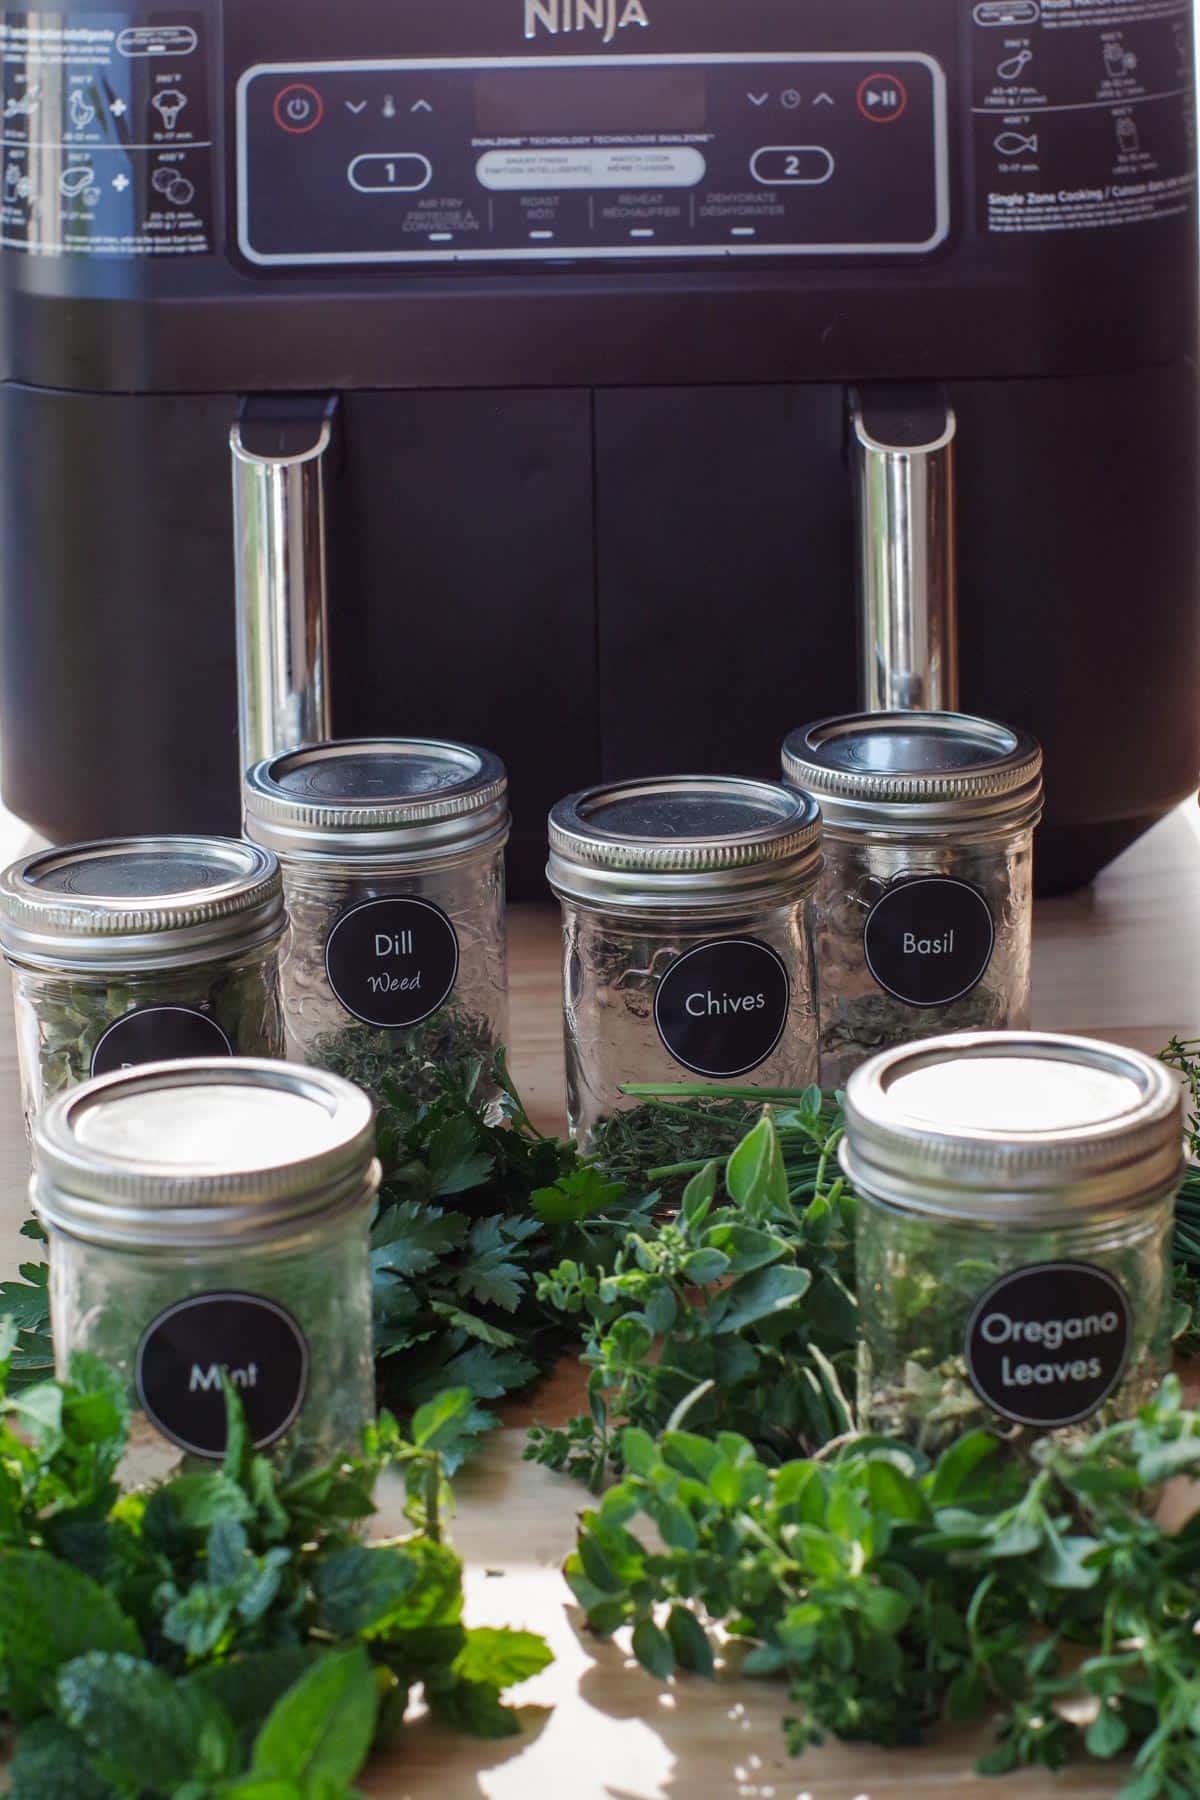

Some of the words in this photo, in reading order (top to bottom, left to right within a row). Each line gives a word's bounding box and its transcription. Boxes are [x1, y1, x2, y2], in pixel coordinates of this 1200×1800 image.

[524, 0, 649, 43] NINJA
[530, 136, 591, 145] TECHNOLOGY
[384, 162, 395, 182] 1
[784, 155, 800, 175] 2
[417, 198, 438, 208] AIR
[439, 198, 464, 208] FRY
[520, 195, 560, 207] ROAST
[618, 193, 664, 204] REHEAT
[706, 192, 776, 203] DEHYDRATE
[987, 193, 1024, 207] Single
[1058, 188, 1103, 203] Cooking
[374, 930, 413, 957] Dill
[902, 929, 954, 954] Basil
[366, 970, 422, 993] Weed
[685, 990, 765, 1016] Chives
[981, 1311, 1119, 1350] Oregano
[188, 1363, 258, 1392] Mnt
[1002, 1355, 1102, 1387] Leaves
